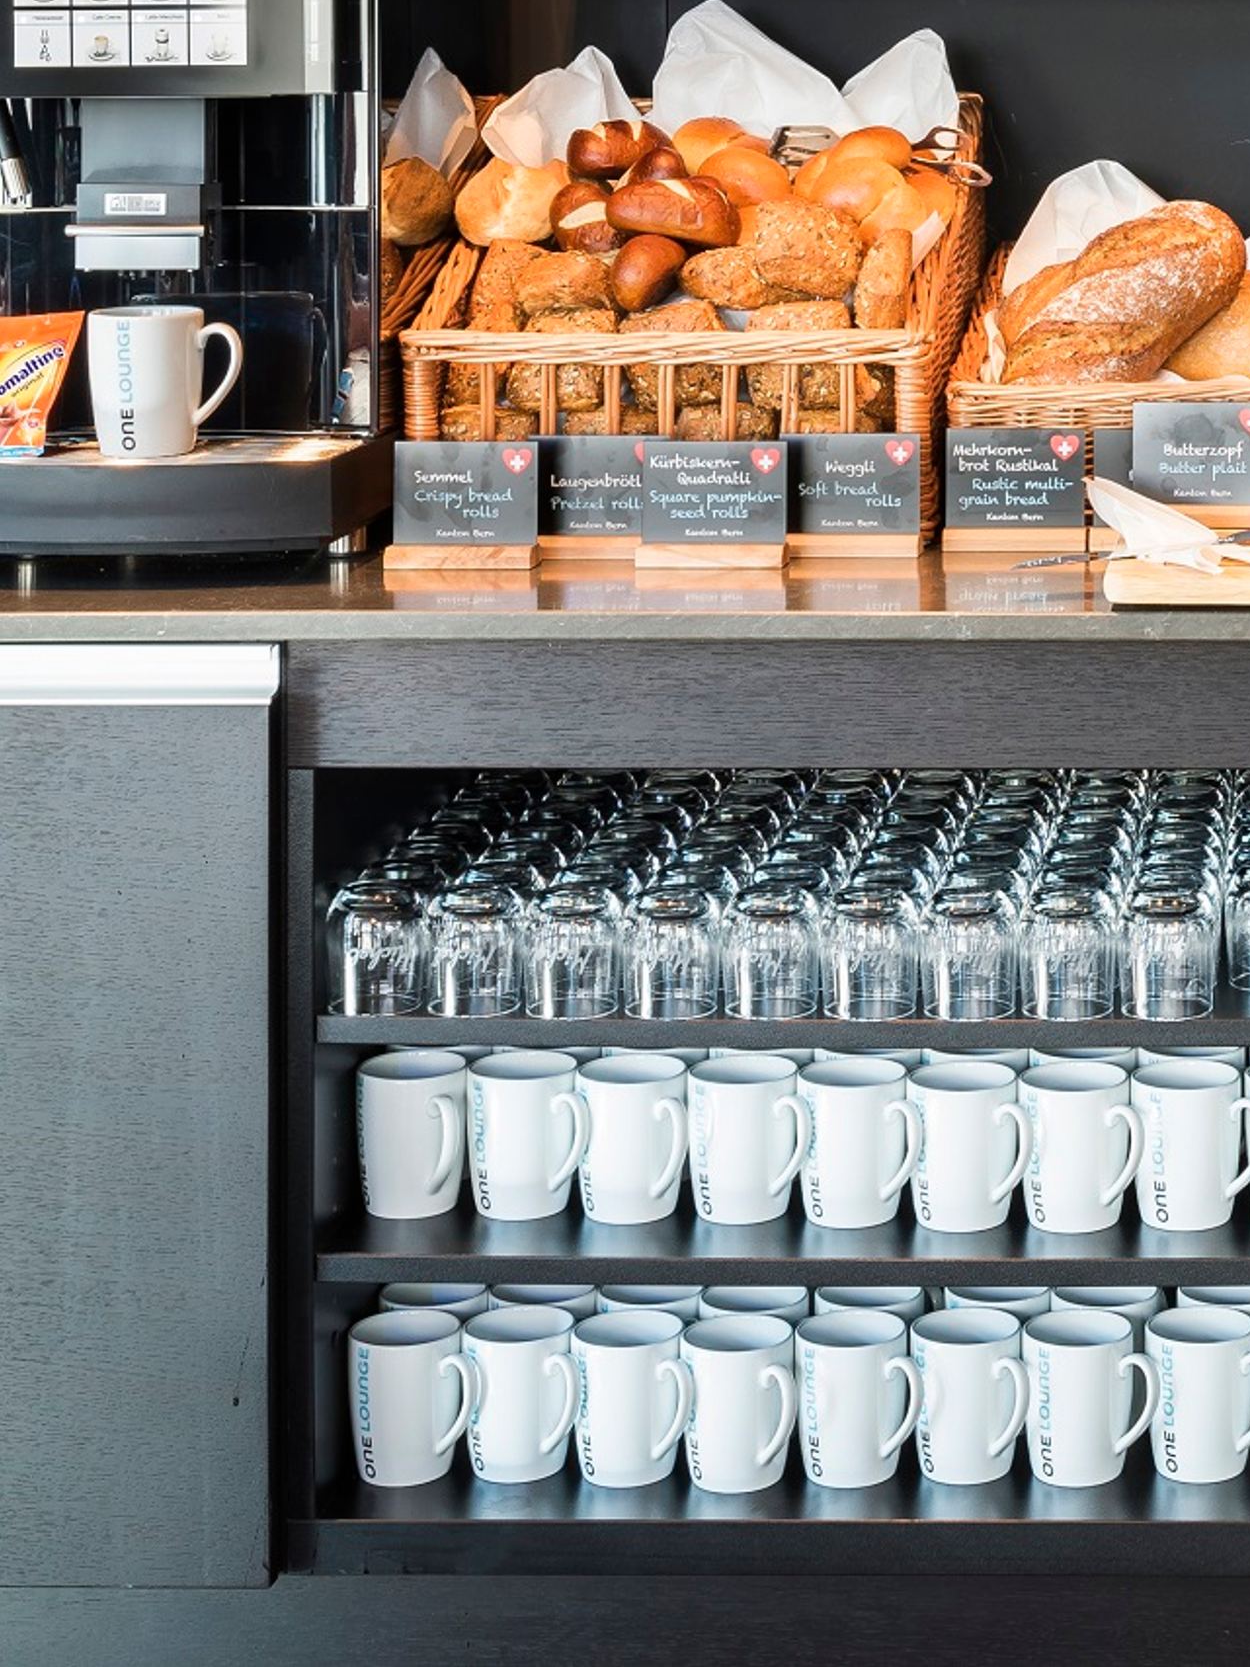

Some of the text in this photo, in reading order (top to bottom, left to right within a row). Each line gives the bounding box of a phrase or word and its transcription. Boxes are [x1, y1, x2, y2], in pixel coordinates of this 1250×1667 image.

[116, 319, 133, 404] LOUNGE
[953, 443, 1033, 458] Mehrkorn-
[1163, 442, 1244, 462] Butterzopf
[650, 453, 741, 471] Kürbiskern-
[825, 460, 876, 477] Weggli
[959, 459, 1059, 473] brot Rustikal
[414, 470, 473, 484] Semmel
[677, 470, 752, 486] Quadratli
[1160, 462, 1247, 481] Butter plait
[550, 472, 642, 491] Laugenbrötl
[972, 477, 1074, 491] Rustic multi-
[414, 487, 514, 509] Crispy bread
[798, 482, 878, 499] Soft bread
[550, 496, 605, 511] Pretzel
[649, 490, 783, 512] Square pumpkin-
[865, 495, 902, 508] rolls
[959, 492, 1049, 511] grain bread
[462, 505, 500, 520] rolls
[670, 505, 749, 520] seed rolls
